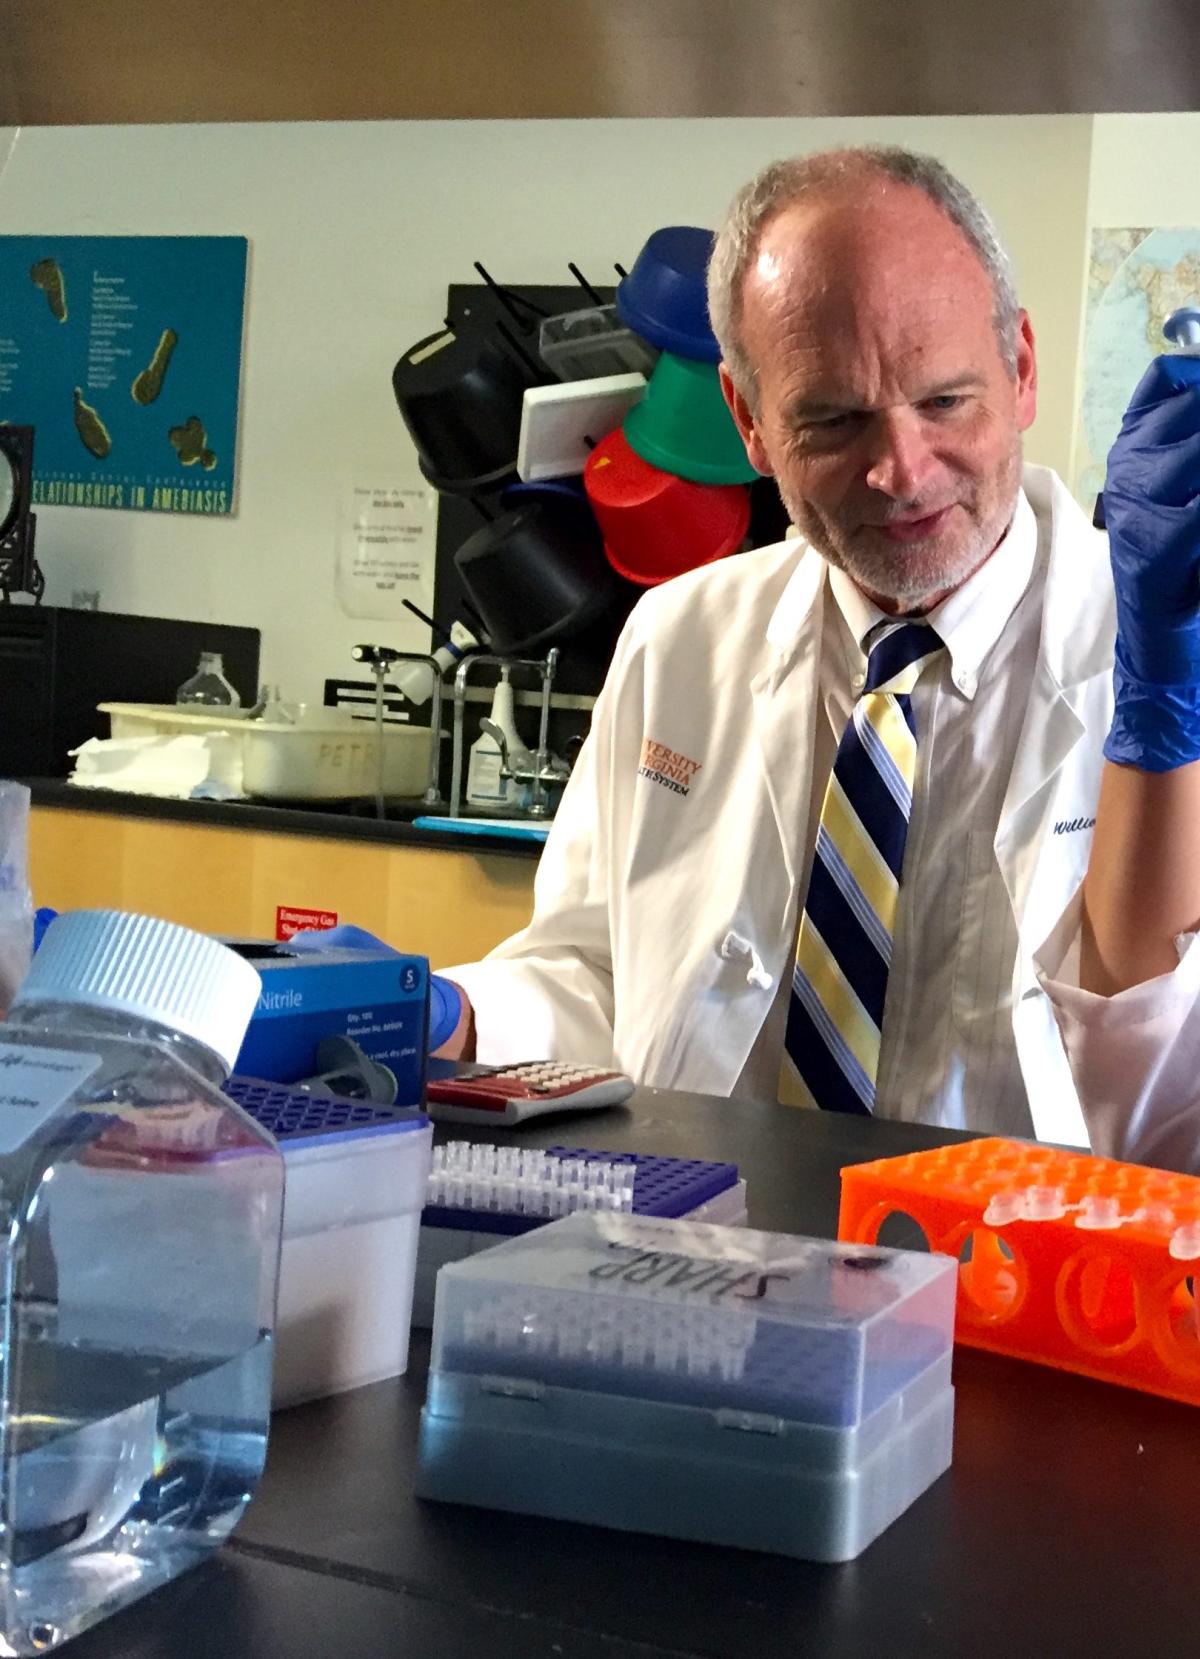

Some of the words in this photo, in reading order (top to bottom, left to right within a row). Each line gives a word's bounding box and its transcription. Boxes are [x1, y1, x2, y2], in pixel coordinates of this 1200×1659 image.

[131, 486, 145, 508] IN
[152, 486, 227, 513] AMEBIASIS
[280, 909, 318, 926] Emergency
[259, 989, 303, 1010] Nitrile
[588, 1251, 790, 1301] SHARP
